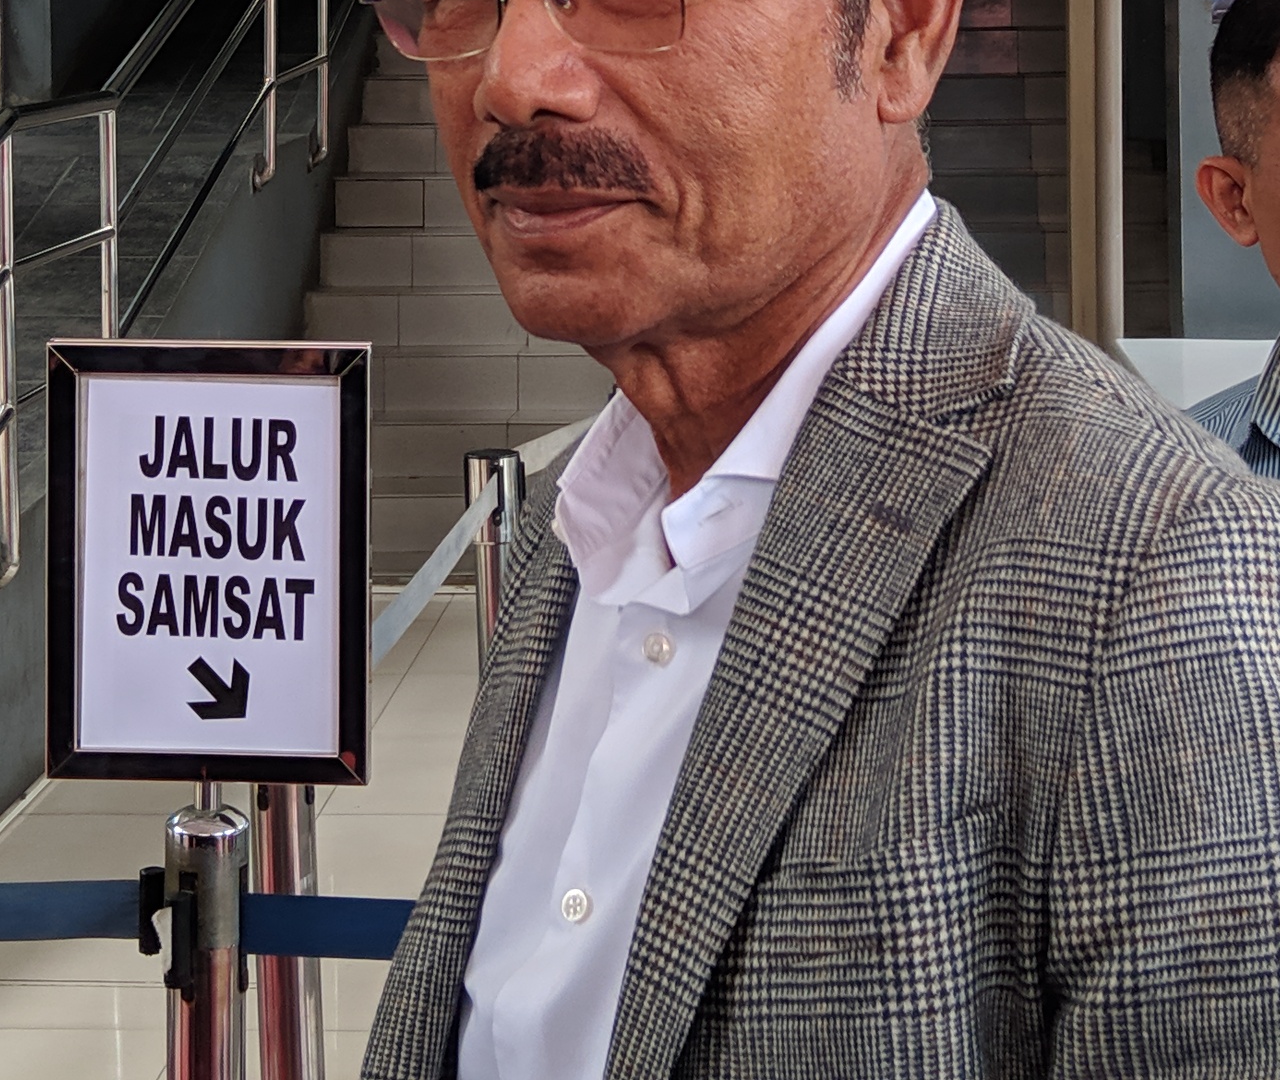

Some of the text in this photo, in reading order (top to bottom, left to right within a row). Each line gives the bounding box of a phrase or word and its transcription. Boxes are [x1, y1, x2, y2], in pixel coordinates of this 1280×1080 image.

[138, 414, 299, 482] JALUR
[128, 493, 307, 561] MASUK
[115, 572, 315, 641] SAMSAT
